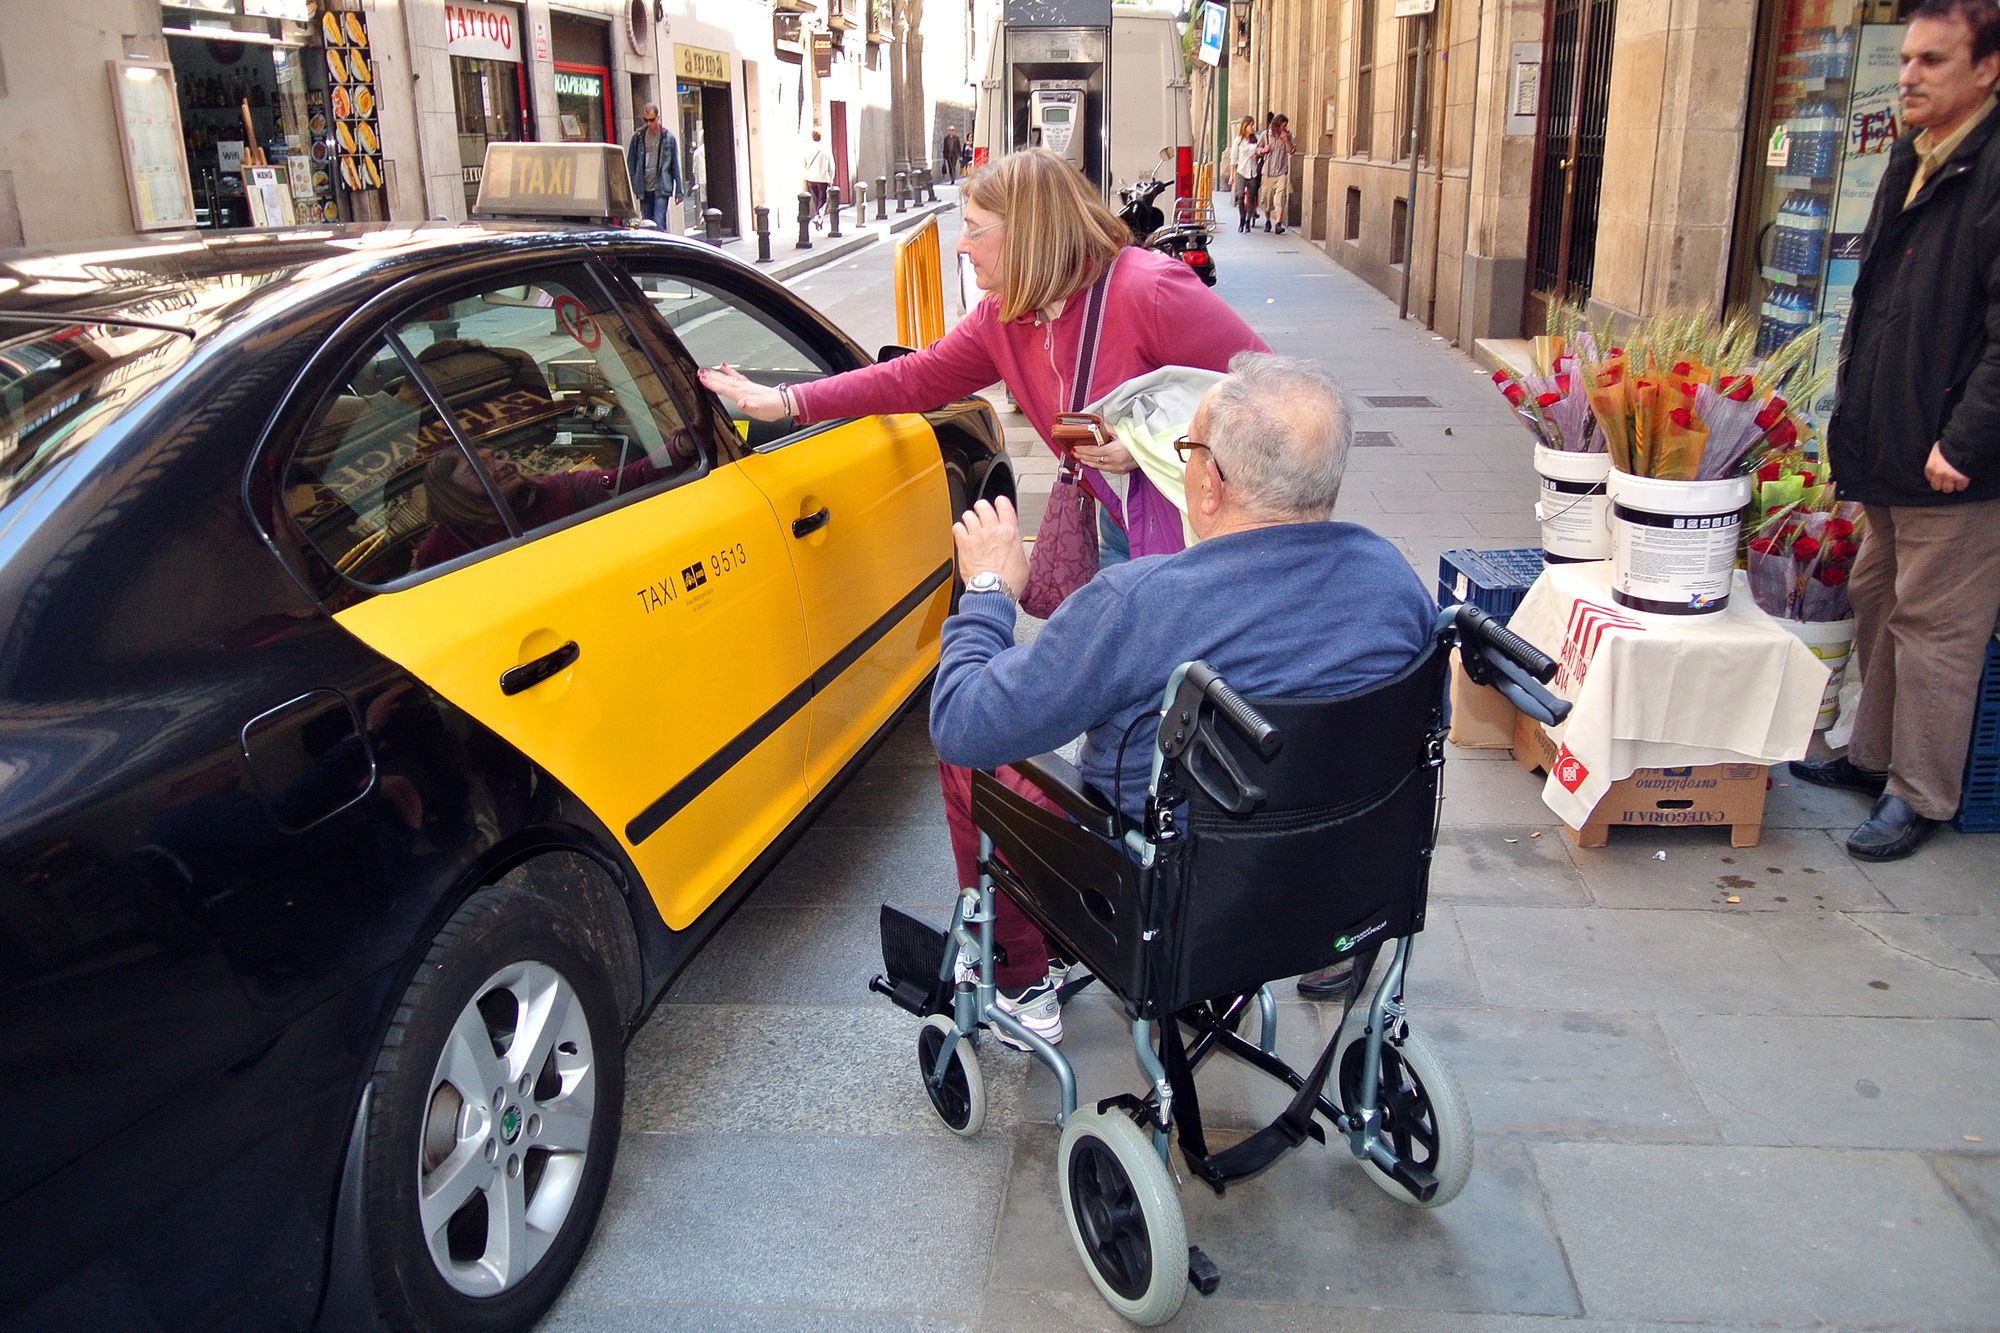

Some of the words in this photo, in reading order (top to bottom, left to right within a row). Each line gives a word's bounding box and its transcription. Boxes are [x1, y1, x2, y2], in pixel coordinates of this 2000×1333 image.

[445, 5, 511, 49] TATTOO
[221, 150, 241, 161] Wifi
[514, 156, 572, 195] TAXI
[637, 576, 678, 614] TAXI
[710, 543, 746, 577] 9513
[1640, 810, 1725, 823] CATEGORIA
